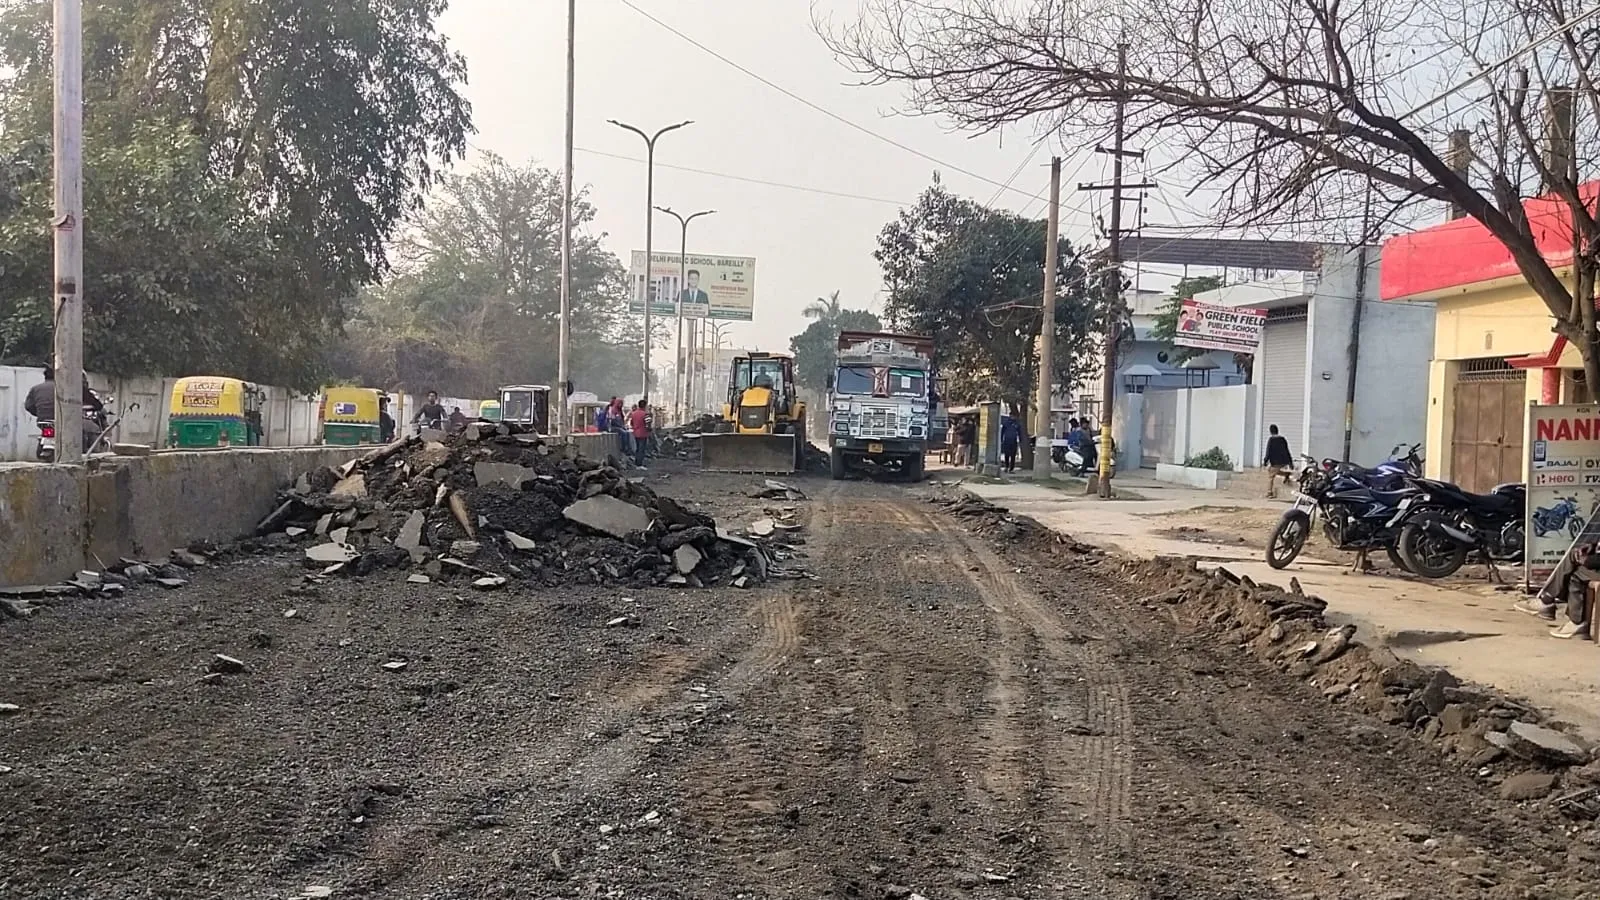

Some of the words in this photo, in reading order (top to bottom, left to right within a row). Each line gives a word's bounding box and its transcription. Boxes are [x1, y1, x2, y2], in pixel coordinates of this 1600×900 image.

[667, 256, 689, 264] PUBLC
[1236, 306, 1256, 314] OPEN
[1205, 310, 1238, 323] GREEN
[1239, 316, 1266, 327] FIELD
[1207, 321, 1230, 331] PUBLIC
[1231, 324, 1259, 334] SCHOOL
[1584, 474, 1600, 483] TV
